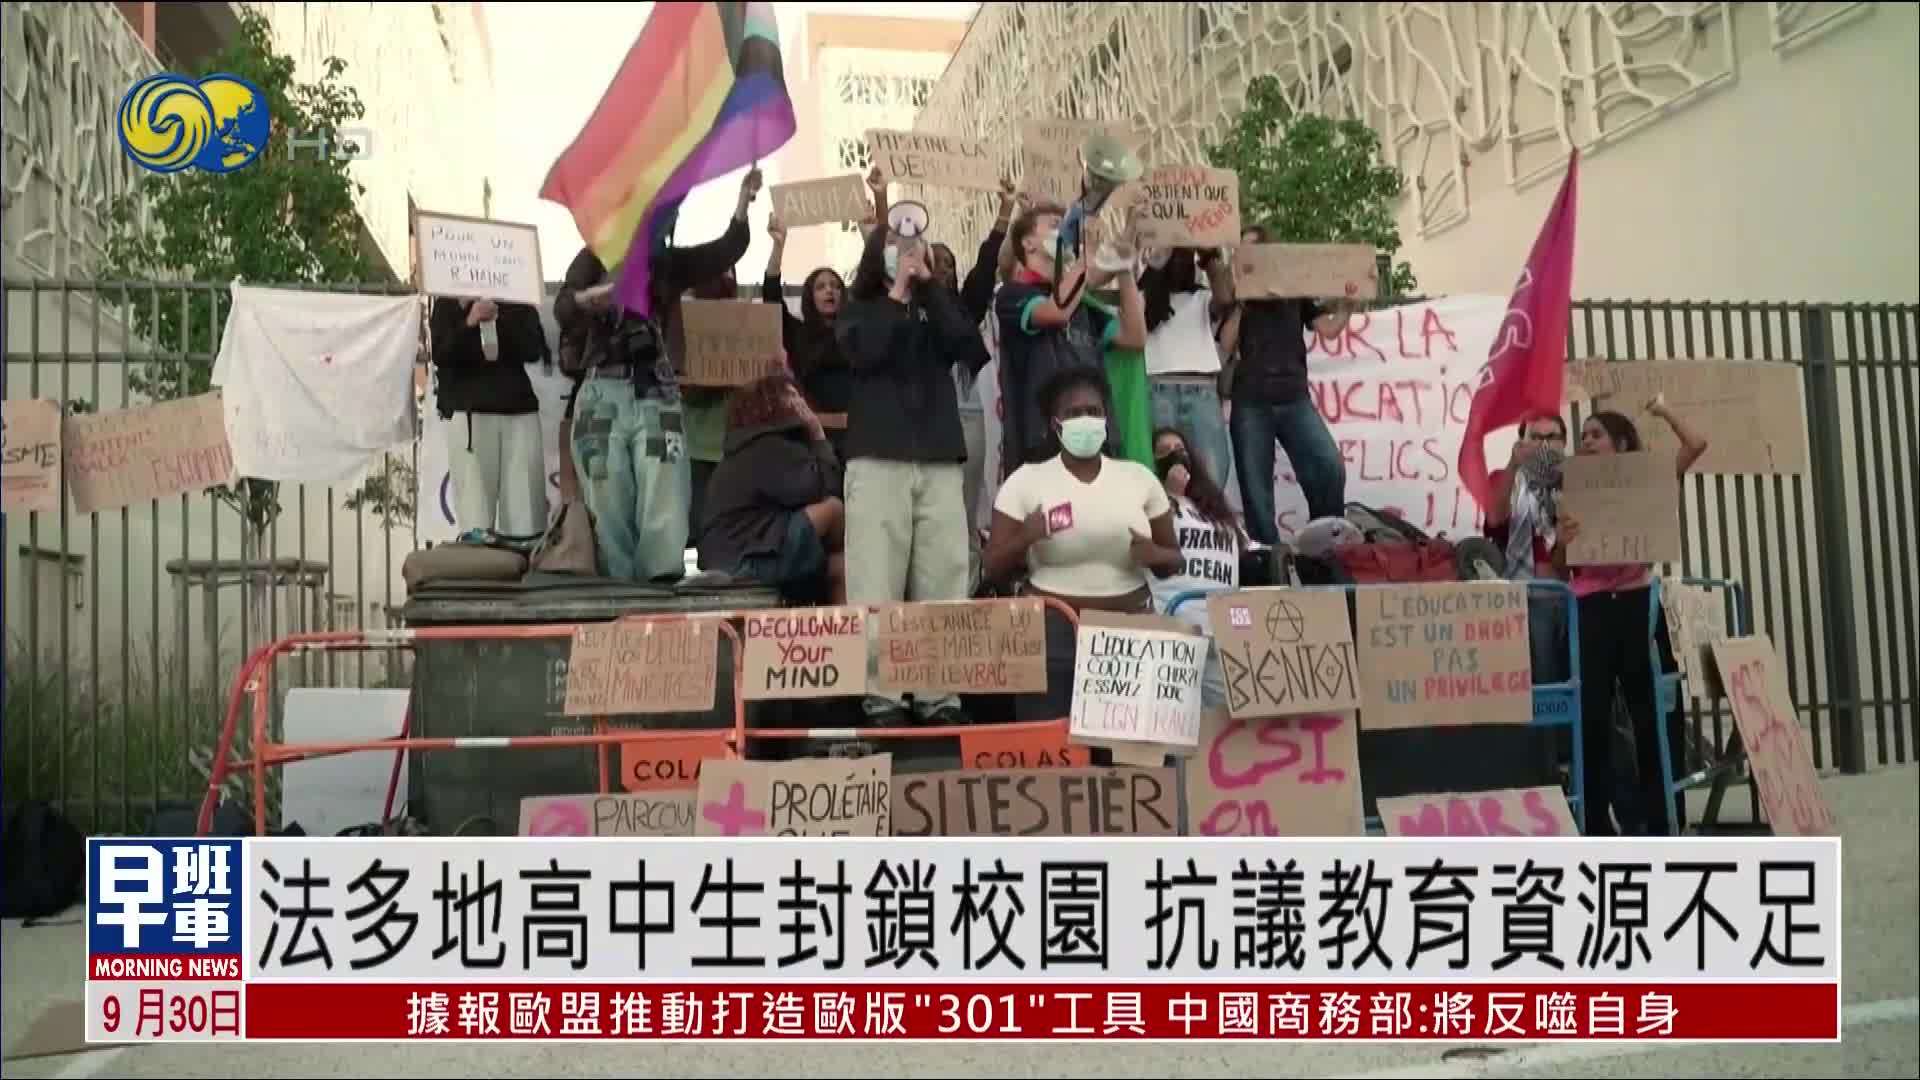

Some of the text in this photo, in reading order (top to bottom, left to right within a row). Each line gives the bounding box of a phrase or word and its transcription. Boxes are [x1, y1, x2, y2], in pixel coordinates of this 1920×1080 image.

[1308, 311, 1386, 363] UR
[1396, 308, 1458, 358] LA
[1308, 366, 1473, 431] UCATIO
[1179, 527, 1234, 553] FRANK
[1424, 624, 1454, 643] UN
[1433, 648, 1480, 673] PAS
[766, 664, 839, 690] MIND
[1386, 679, 1418, 704] UN
[974, 748, 1071, 768] COLAS
